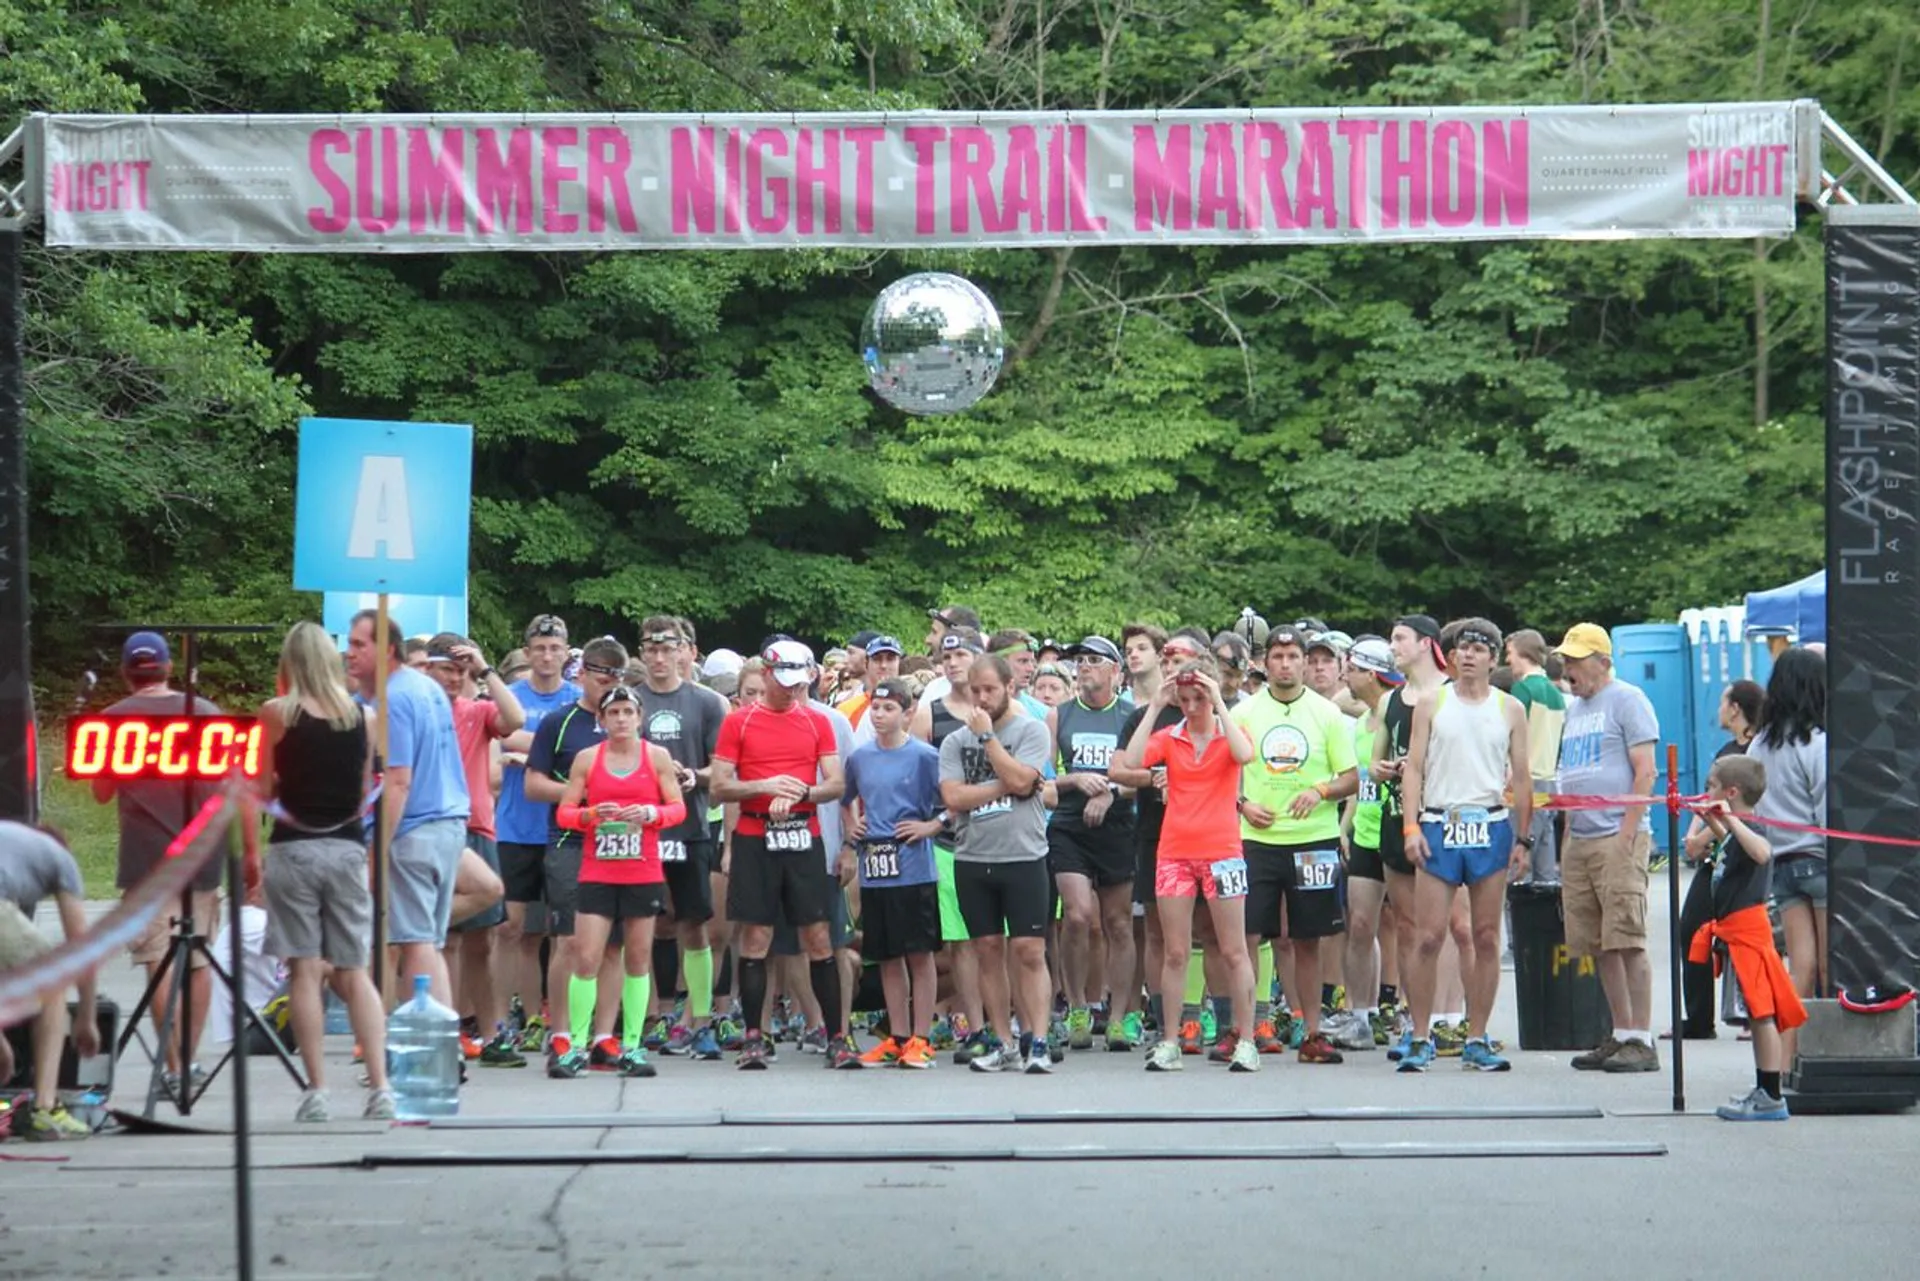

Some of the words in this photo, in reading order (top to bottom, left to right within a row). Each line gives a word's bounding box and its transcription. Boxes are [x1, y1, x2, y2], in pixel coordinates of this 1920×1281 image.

[1687, 112, 1788, 147] SUMMER
[308, 126, 638, 234] SUMMER
[671, 126, 885, 234] NIGHT
[904, 124, 1107, 233] TRAIL
[1134, 120, 1529, 231] MARATHON
[1687, 144, 1788, 197] NIGHT
[1884, 281, 1899, 434] TIMING
[1839, 272, 1880, 584] FLASHPOINT
[347, 455, 414, 560] A
[1884, 478, 1899, 584] RACE
[595, 834, 641, 857] 2538
[1443, 823, 1490, 845] 2604
[864, 854, 899, 877] 1891
[1303, 864, 1334, 886] 967
